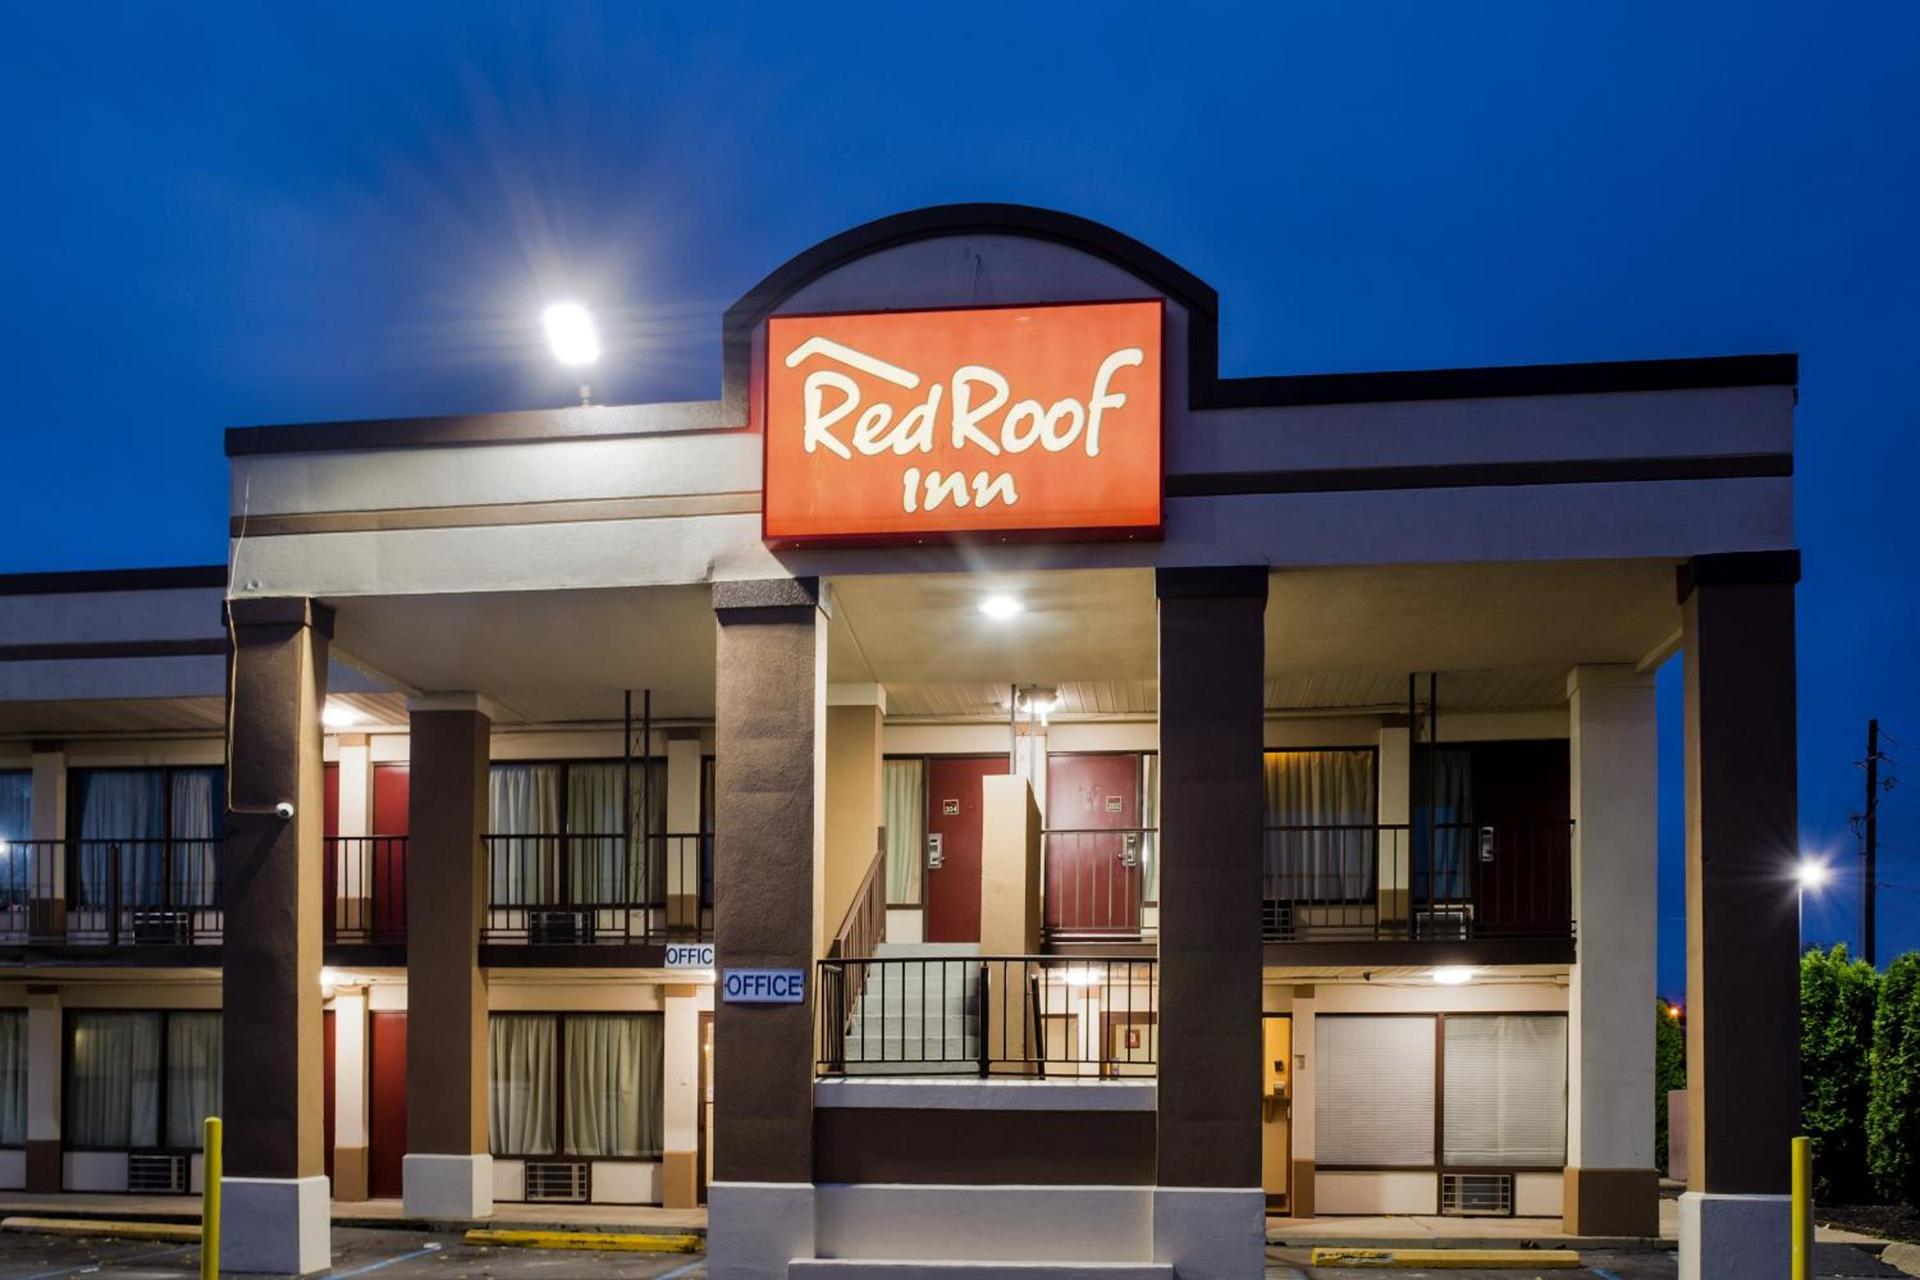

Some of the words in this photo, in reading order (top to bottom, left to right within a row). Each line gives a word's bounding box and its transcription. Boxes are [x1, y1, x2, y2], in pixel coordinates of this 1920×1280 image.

[803, 370, 943, 460] Red
[951, 347, 1143, 457] Roof
[666, 948, 713, 964] OFFIC
[727, 975, 801, 996] OFFICE
